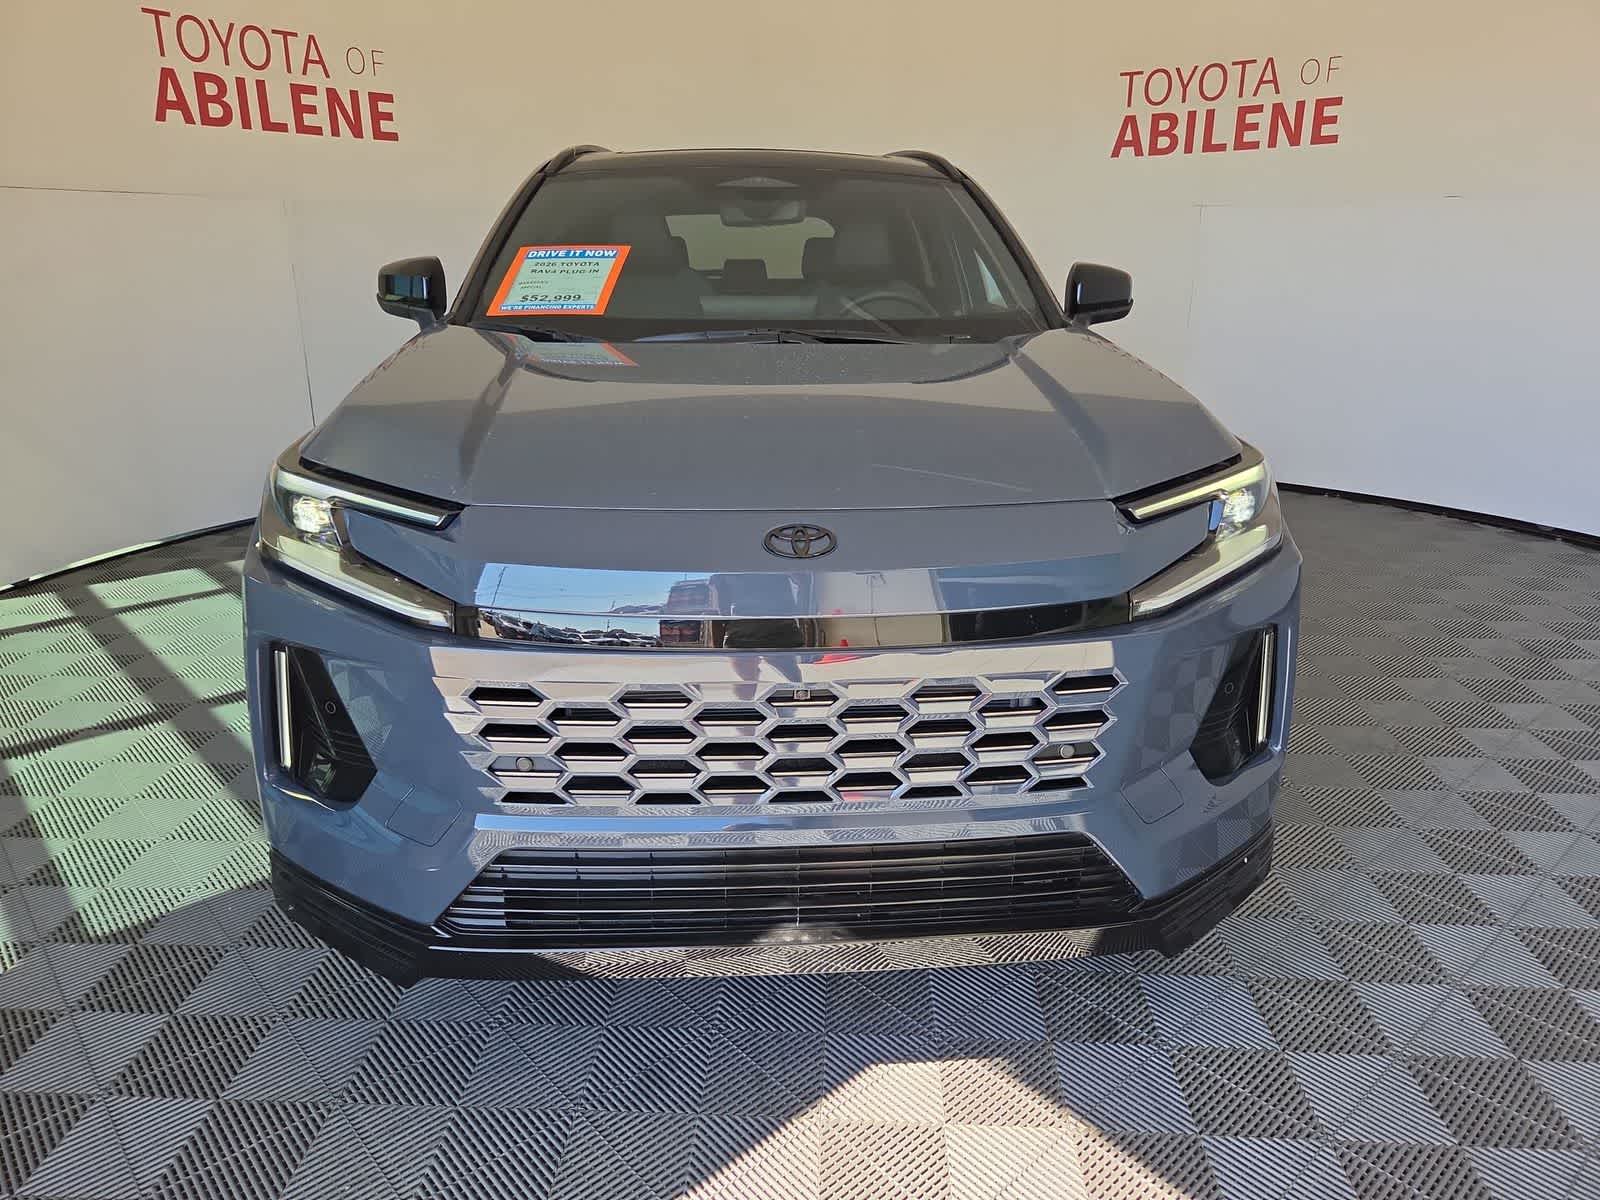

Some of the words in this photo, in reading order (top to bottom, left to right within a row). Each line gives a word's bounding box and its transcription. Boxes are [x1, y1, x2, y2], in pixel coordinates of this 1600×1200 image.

[141, 8, 331, 79] TOYOTA
[345, 46, 385, 77] OF
[155, 67, 399, 142] ABILENE
[1119, 56, 1280, 108] TOYOTA
[1300, 55, 1343, 86] OF
[1110, 96, 1344, 158] ABILENE
[527, 250, 566, 258] DRIVE
[519, 294, 582, 303] $52,999
